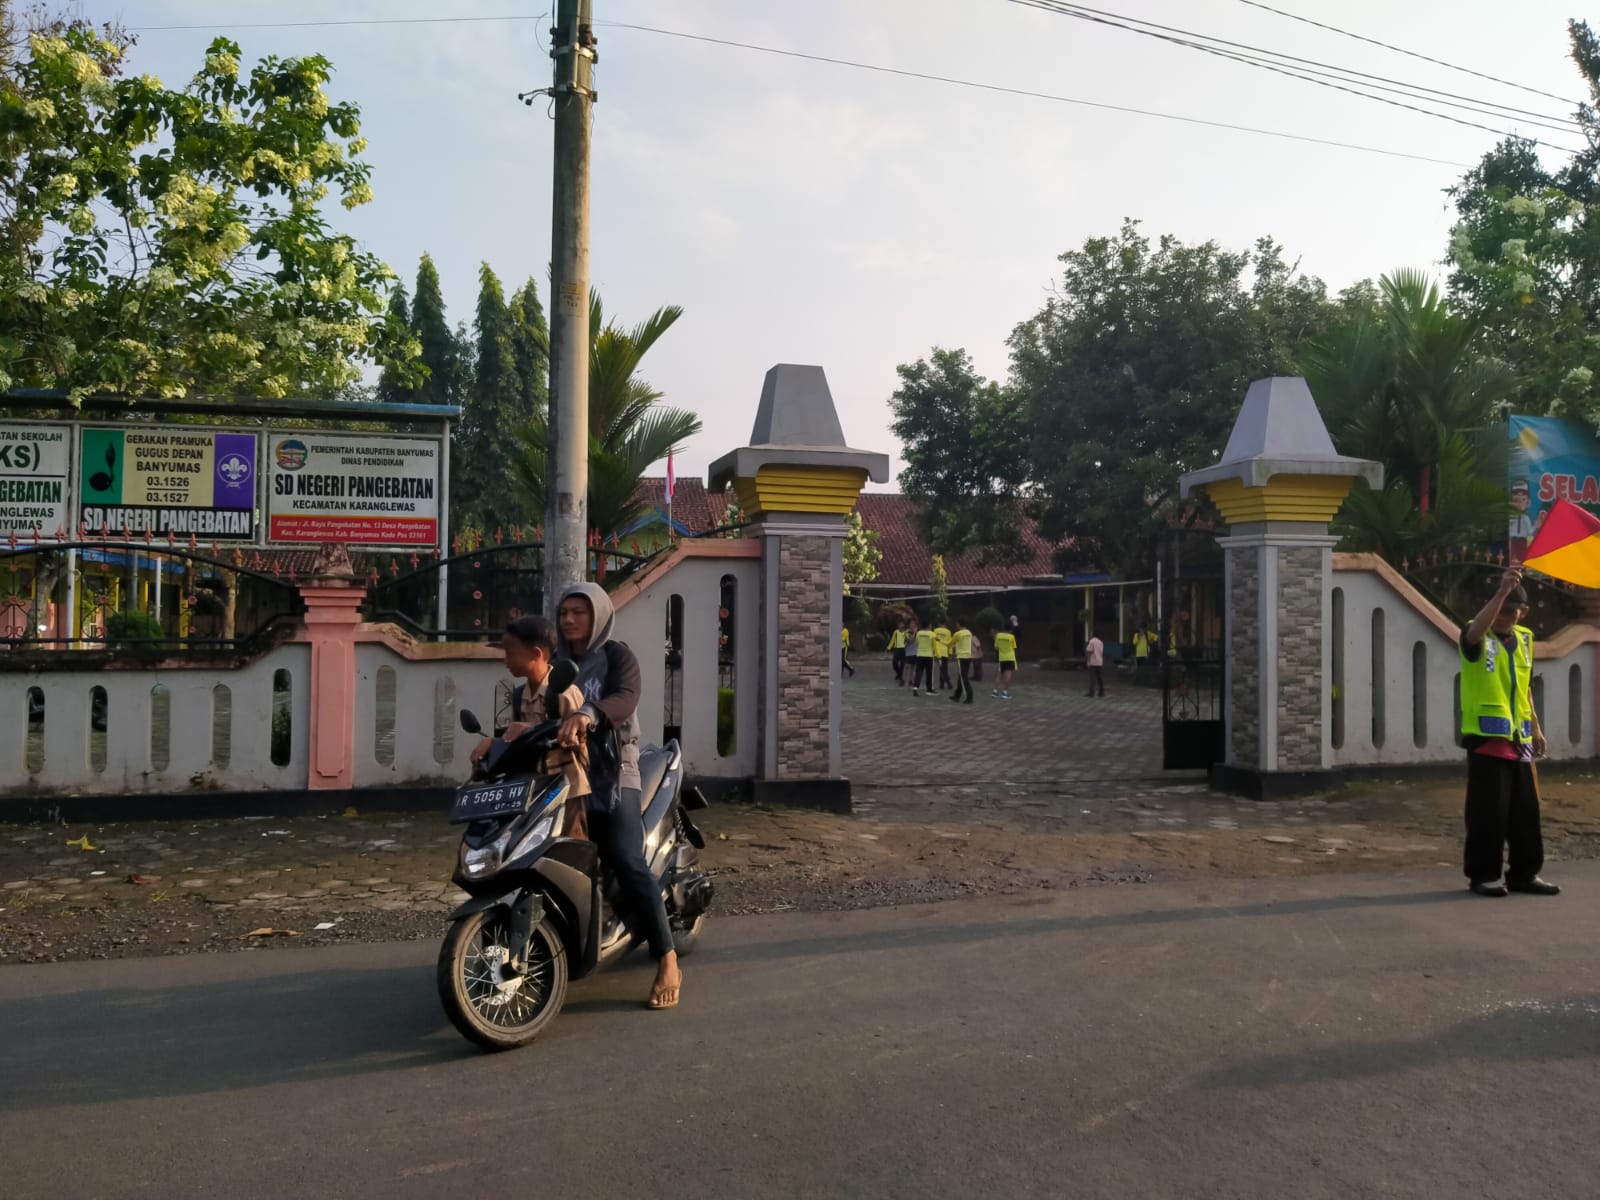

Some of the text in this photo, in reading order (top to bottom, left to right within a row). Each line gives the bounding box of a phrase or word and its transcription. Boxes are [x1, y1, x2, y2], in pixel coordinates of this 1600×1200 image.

[0, 431, 63, 442] TAN SEKOLAH
[126, 434, 213, 447] GERAKAN PRAMUKA
[135, 448, 204, 460] GUGUS DEPAN
[311, 445, 434, 458] PEMERINTAH KABUPATEN BANYUMAS
[136, 461, 201, 474] BANYUMAS
[341, 457, 405, 468] DINAS PENDIDIKAN
[146, 477, 190, 488] 03.1526
[275, 474, 434, 500] SD NEGERI PANGEBATAN
[1538, 472, 1600, 504] SELA
[0, 479, 61, 503] GEBATAN
[146, 492, 190, 504] 03.1527
[292, 500, 416, 512] KECAMATAN KARANGLEWAS
[0, 519, 43, 530] YUMAS
[84, 507, 250, 535] SD NEGERI PANGEBATAN
[461, 786, 524, 806] R 5056 HV
